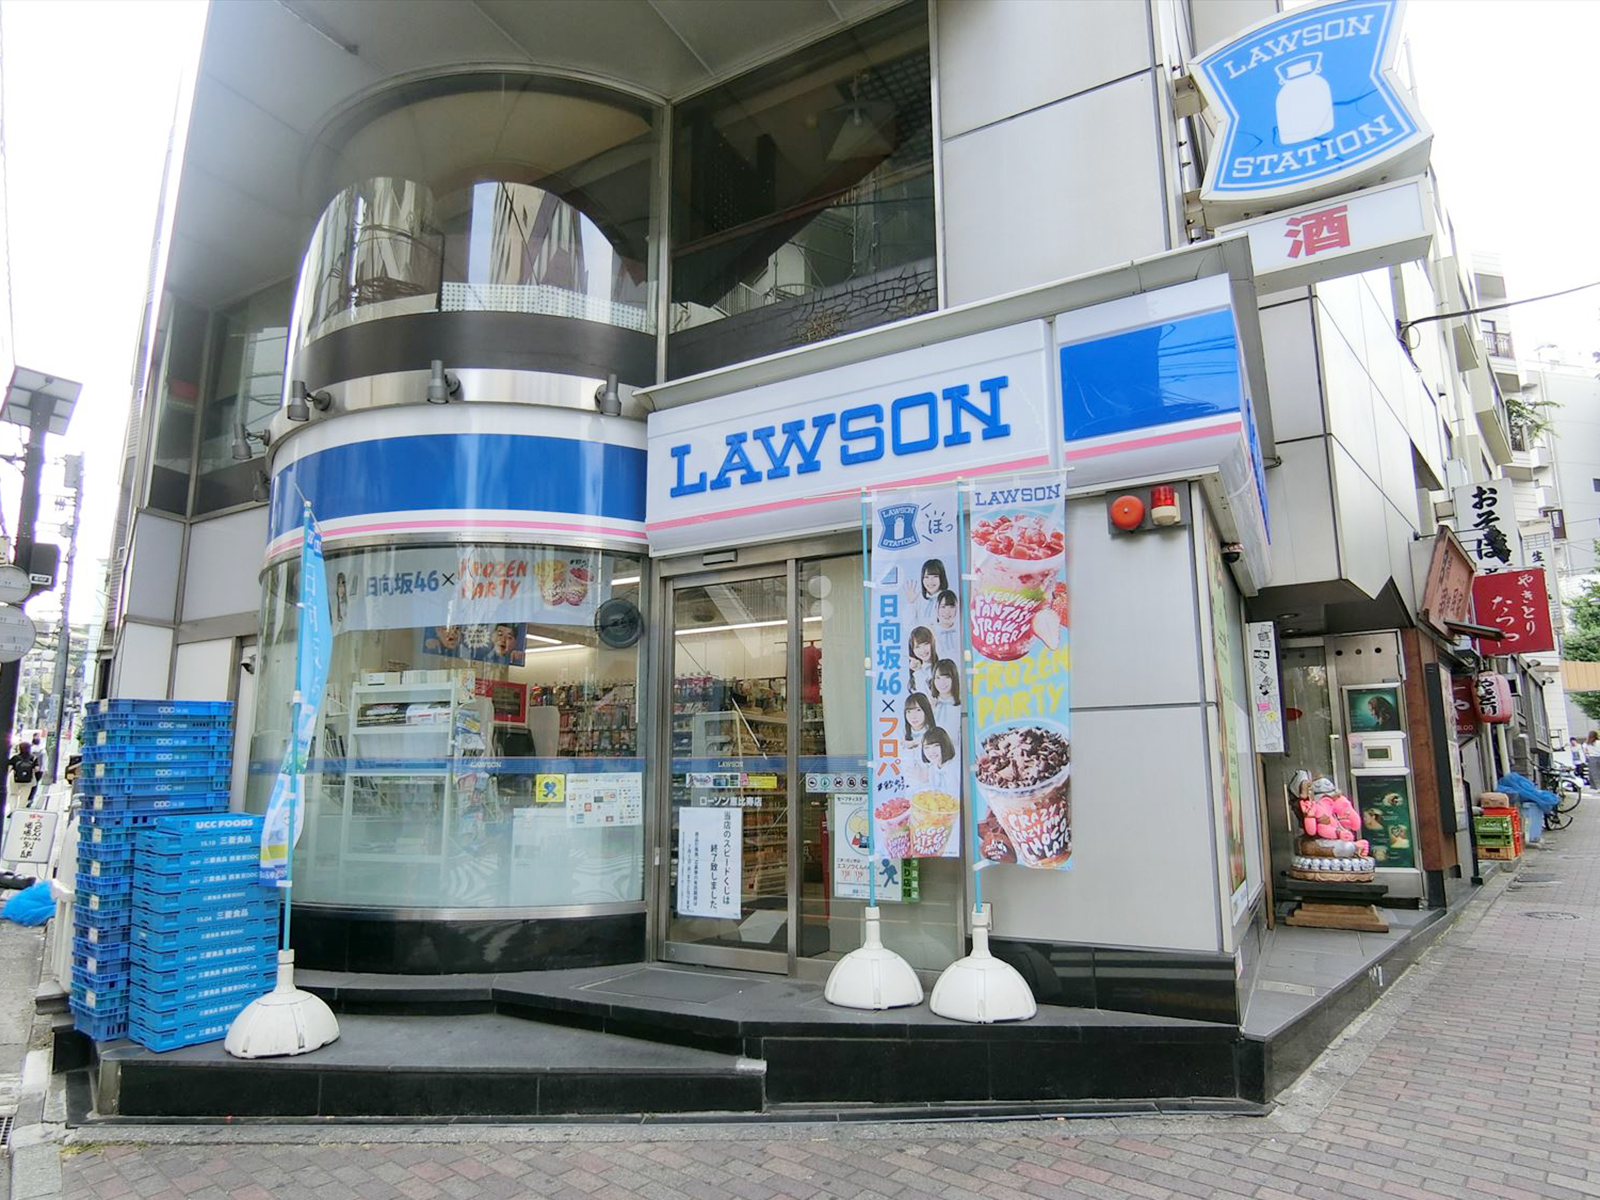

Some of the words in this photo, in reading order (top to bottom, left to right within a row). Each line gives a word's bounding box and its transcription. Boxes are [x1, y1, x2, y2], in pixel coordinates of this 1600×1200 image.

[1223, 13, 1375, 79] LAWSON
[1231, 114, 1394, 178] STATION
[1284, 204, 1350, 259] 酒
[669, 374, 1011, 499] LAWSON
[881, 506, 916, 518] LAWSON
[975, 483, 1061, 506] LAWSON
[882, 535, 916, 547] STATION
[458, 559, 528, 581] FROZEN
[462, 579, 521, 599] PARTY
[1517, 574, 1536, 636] やきとり
[972, 643, 1072, 696] FROZEN
[977, 682, 1064, 729] PARTY
[196, 821, 217, 829] UCC
[218, 819, 254, 828] FOODS
